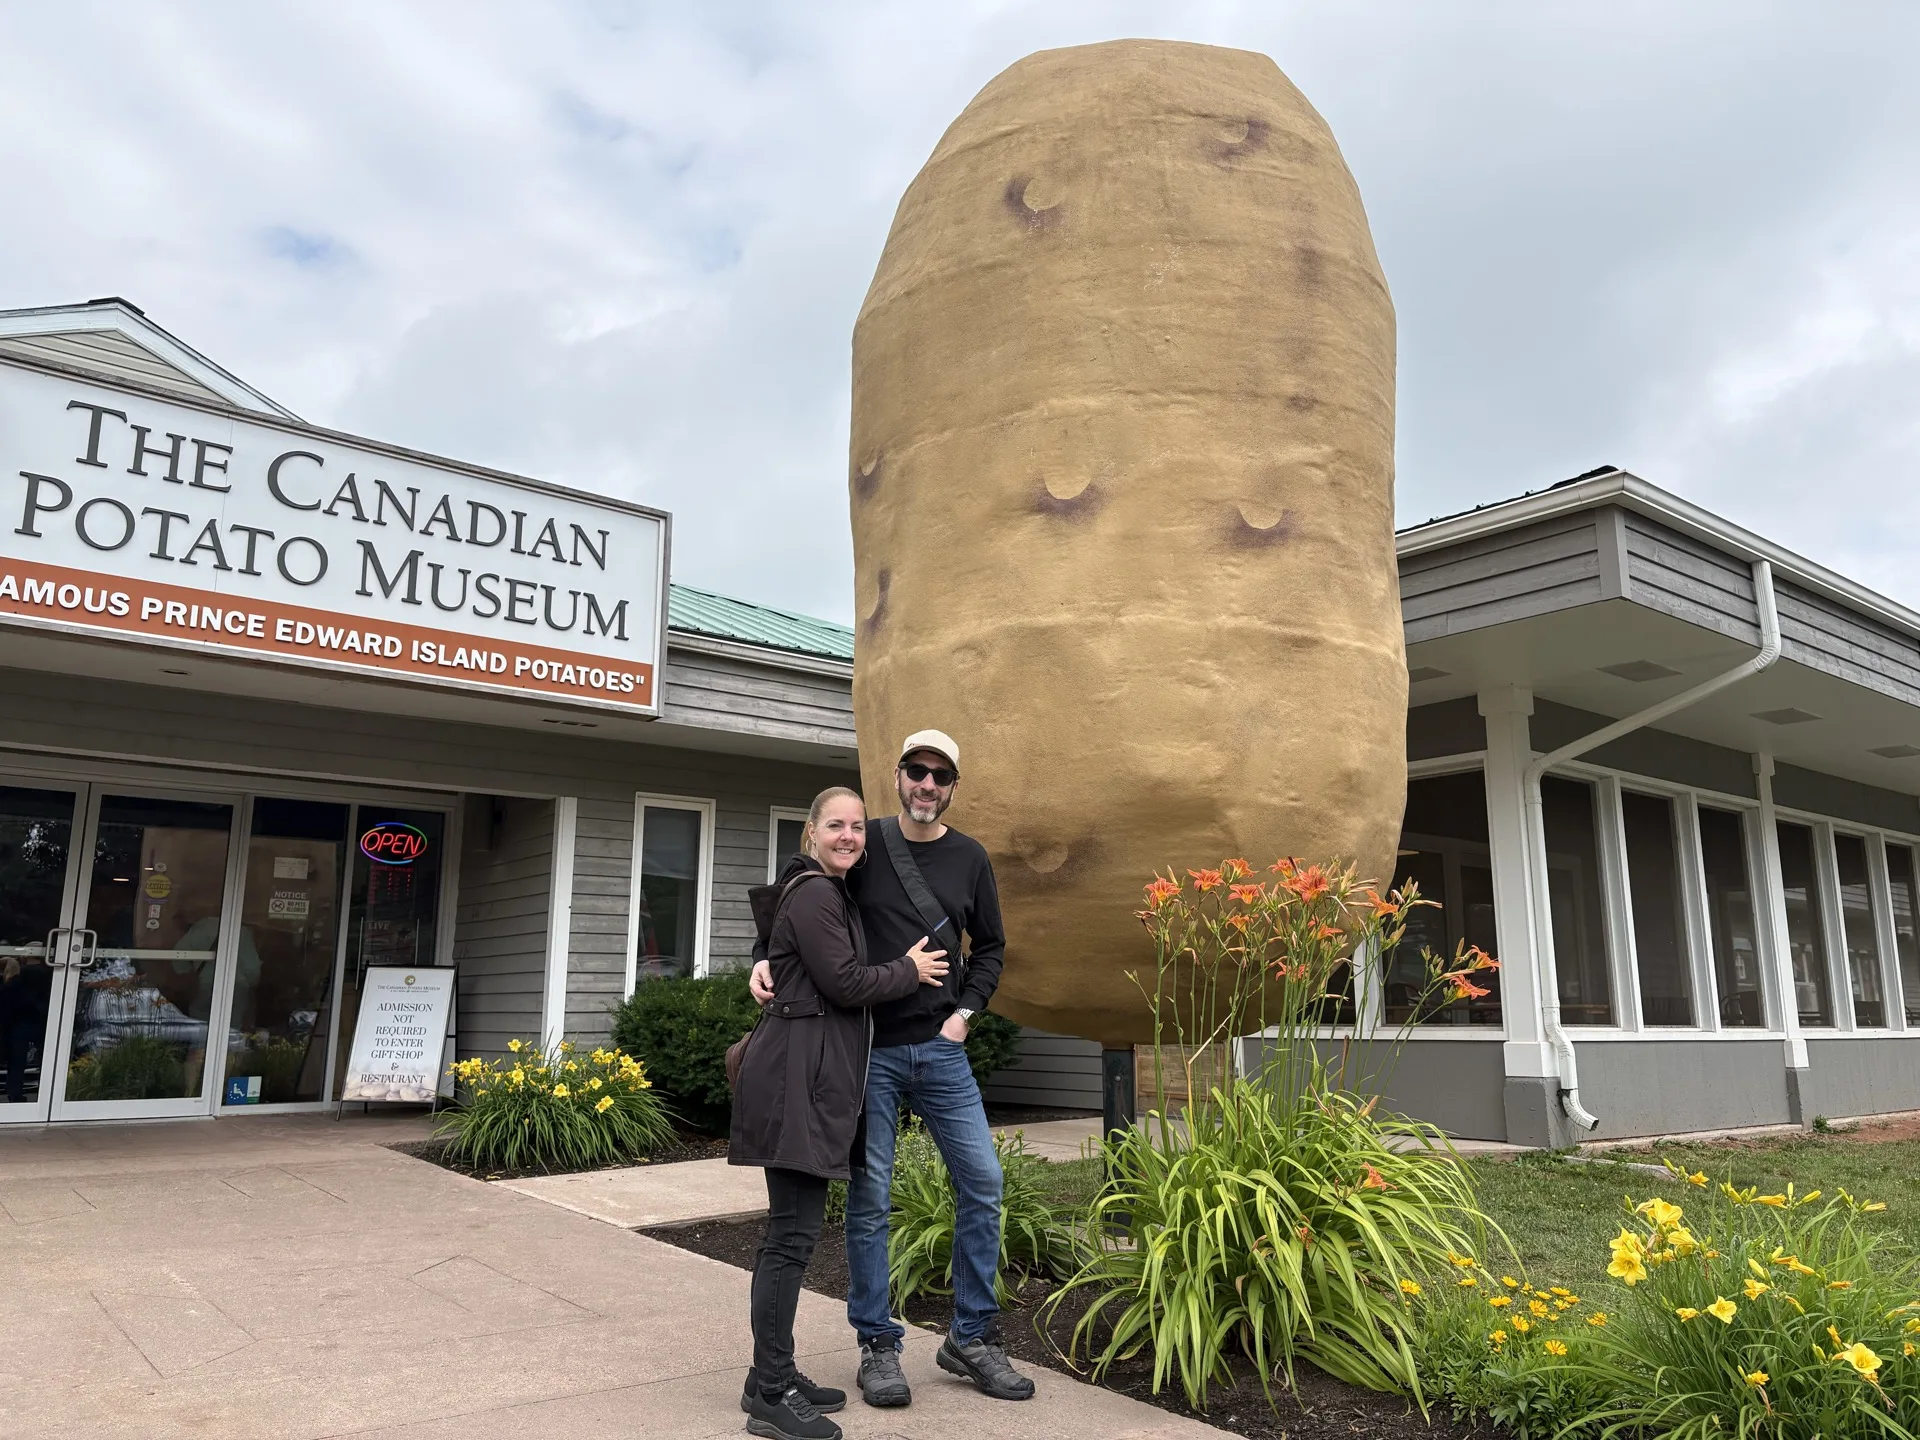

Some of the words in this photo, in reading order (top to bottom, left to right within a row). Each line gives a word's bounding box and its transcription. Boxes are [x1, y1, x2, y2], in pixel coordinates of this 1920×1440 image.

[66, 399, 234, 493] THE
[267, 450, 610, 571] CANADIAN
[14, 470, 329, 586] POTATO
[355, 538, 630, 641] MUSEUM
[140, 597, 266, 638] PRINCE
[274, 618, 403, 658] EDWARD
[411, 639, 507, 674] ISLAND
[514, 656, 645, 694] POTATOES"
[363, 831, 422, 855] OPEN
[274, 890, 307, 899] NOTICE
[376, 1002, 434, 1012] ADMISSION
[392, 1014, 415, 1024] NOT
[375, 1026, 427, 1037] REQUIRED
[375, 1038, 389, 1047] TO
[390, 1038, 424, 1048] ENTER
[370, 1050, 394, 1059] GIFT
[395, 1050, 424, 1059] SHOP
[390, 1062, 399, 1071] &
[360, 1074, 426, 1084] RESTAURANT
